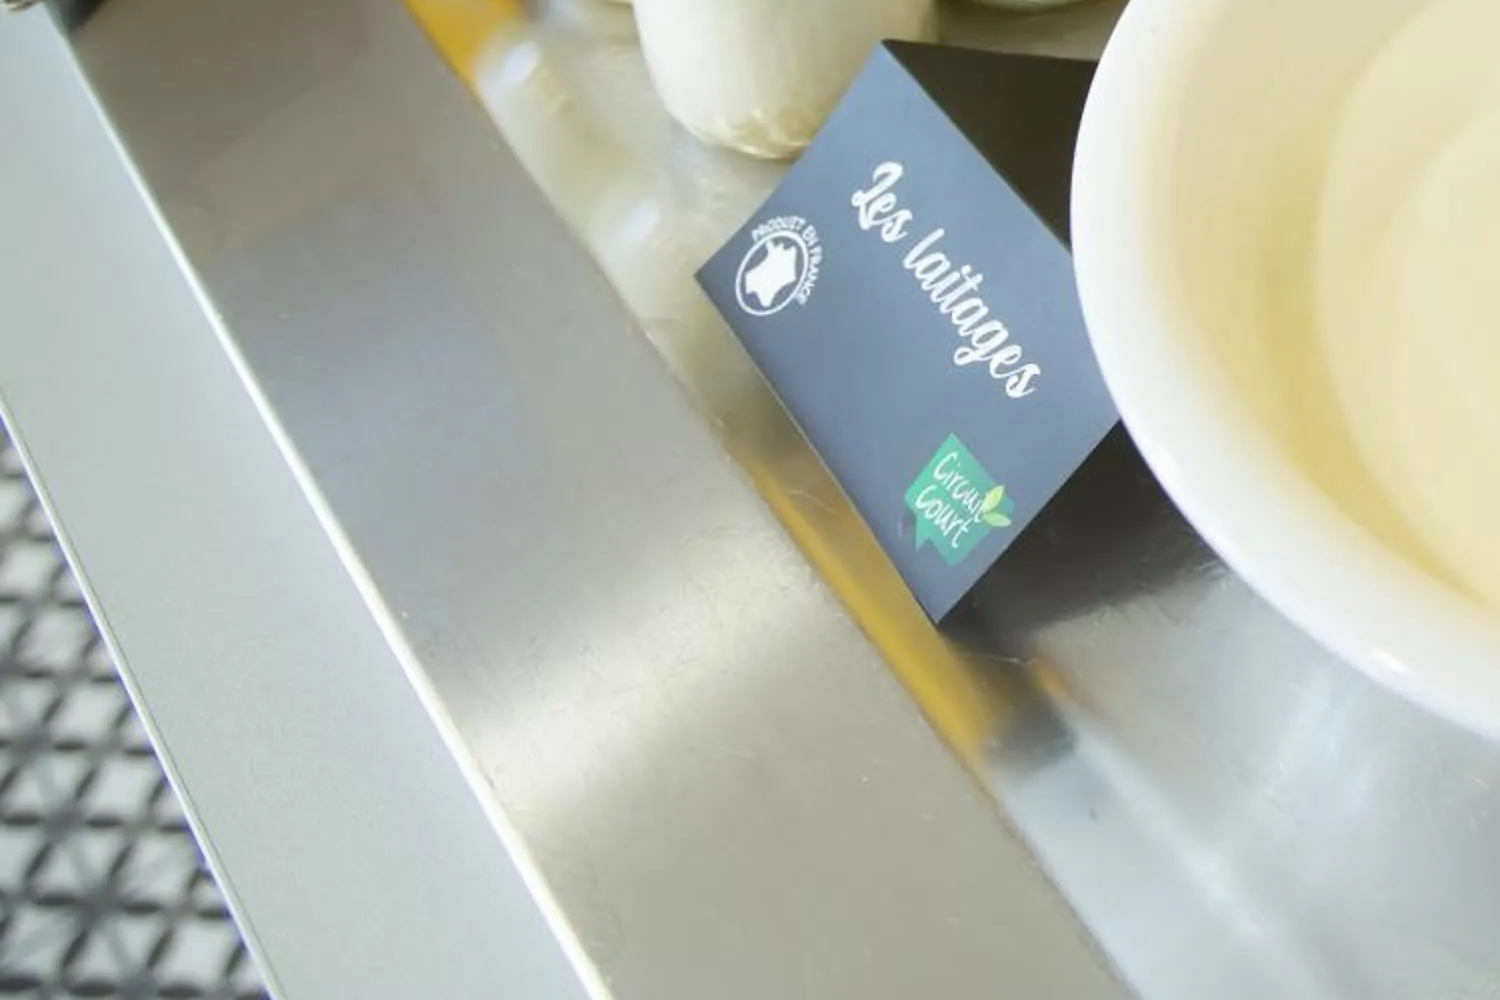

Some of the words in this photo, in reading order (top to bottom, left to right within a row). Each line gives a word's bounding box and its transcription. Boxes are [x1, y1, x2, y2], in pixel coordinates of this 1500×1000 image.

[751, 215, 807, 243] PRODUIT
[852, 161, 914, 243] Les
[903, 228, 1041, 399] laitages
